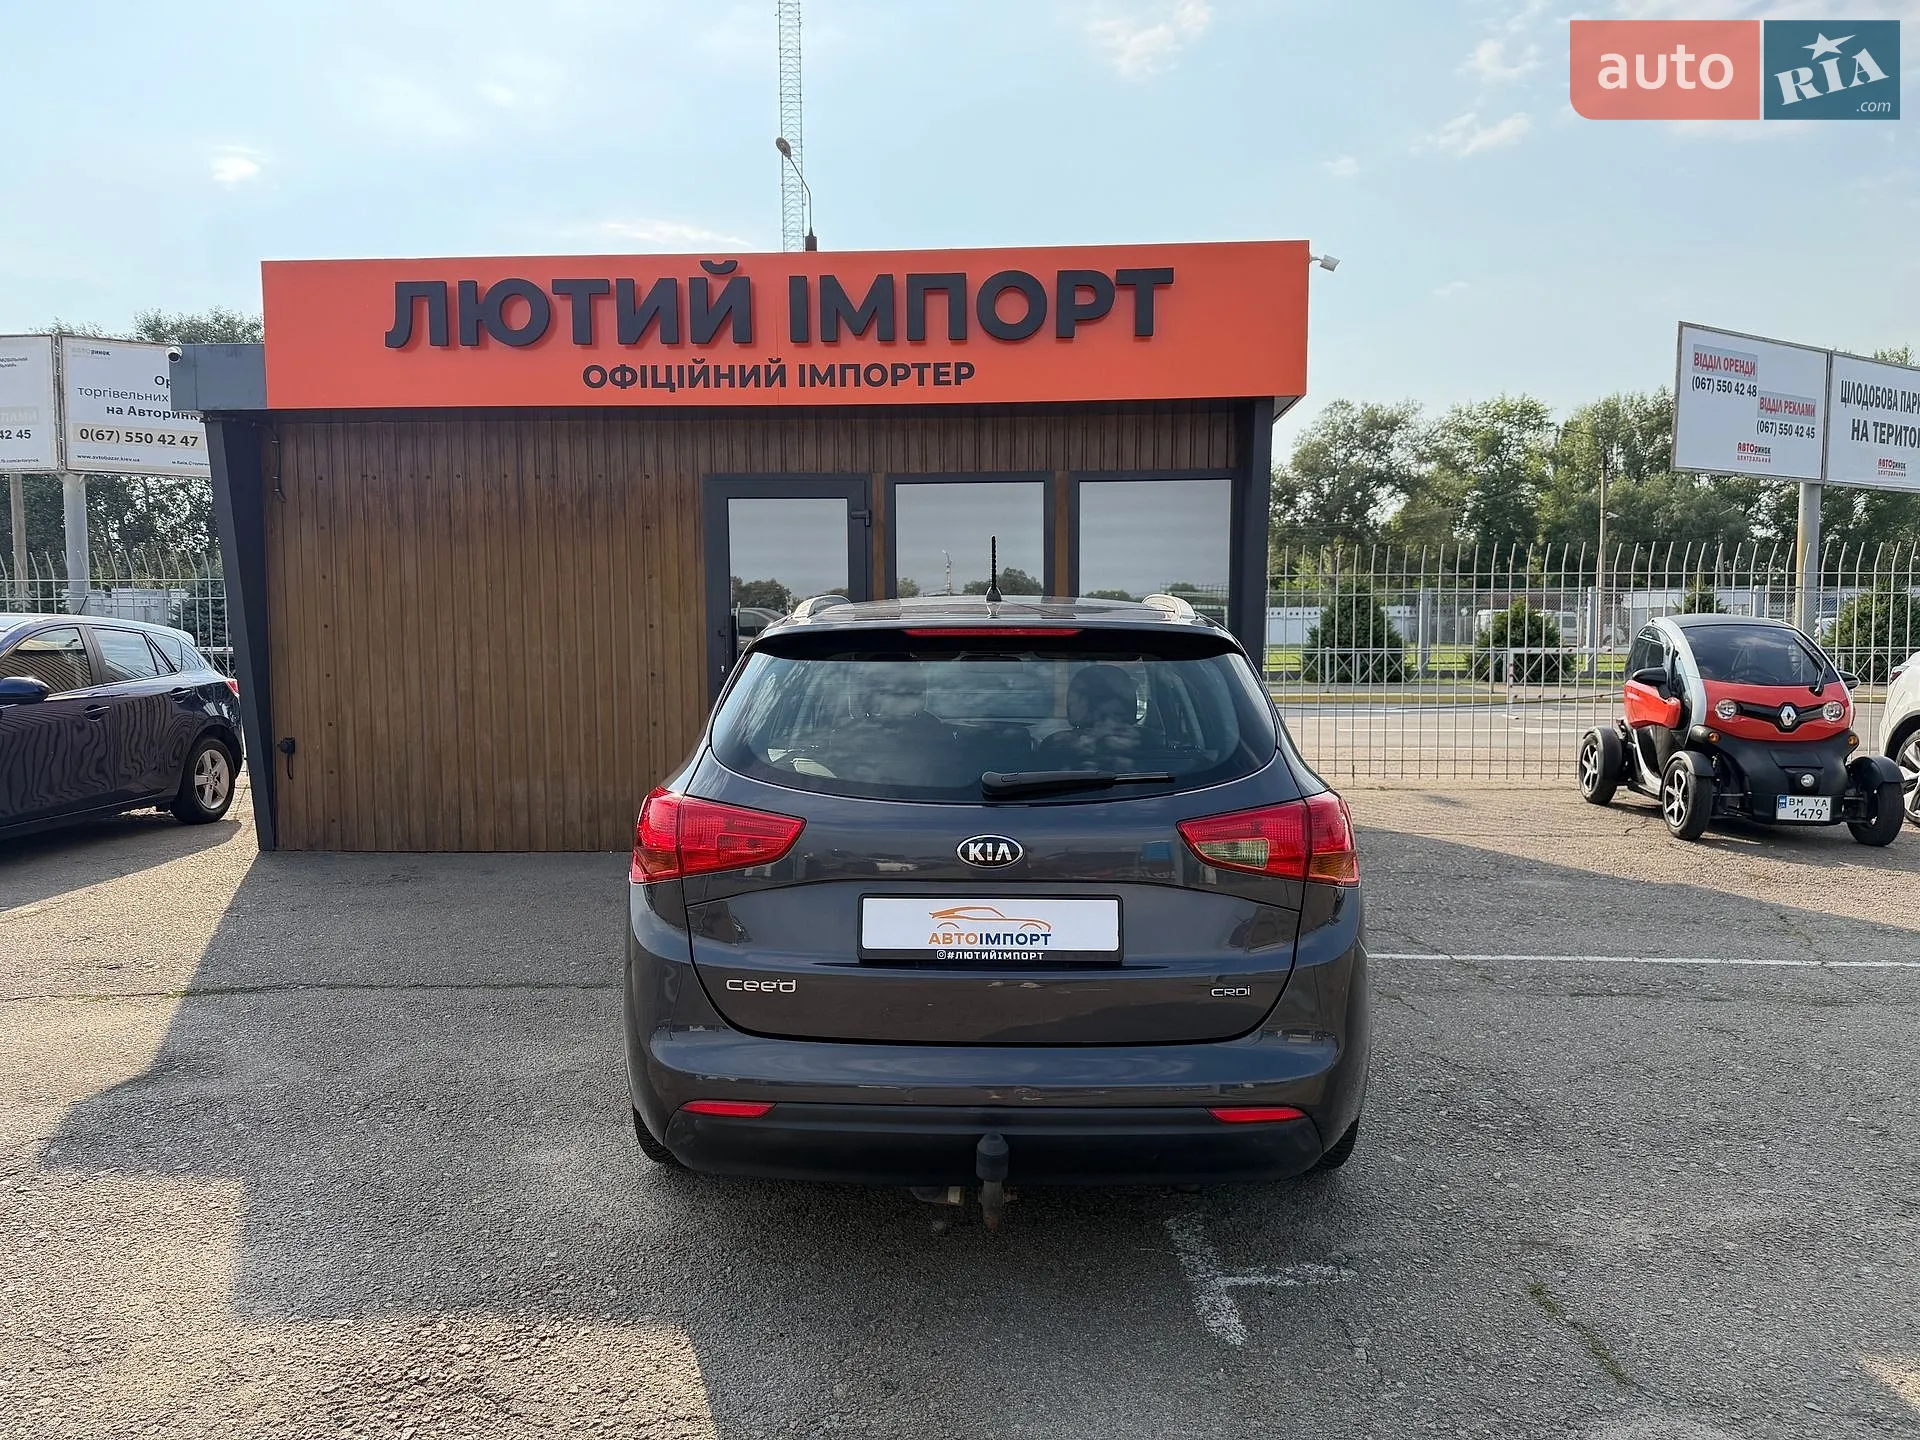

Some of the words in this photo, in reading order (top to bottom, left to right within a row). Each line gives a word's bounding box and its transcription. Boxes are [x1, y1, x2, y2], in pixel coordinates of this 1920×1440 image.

[385, 260, 753, 349] ЛЮТИЙ
[788, 267, 1174, 343] ІМПОРТ
[1693, 351, 1722, 372] ВІДДІЛ
[1723, 357, 1756, 377] ОРЕНДИ
[582, 358, 787, 393] ОФІЦІЙНИЙ
[799, 361, 976, 388] ІМПОРТЕР
[78, 386, 169, 402] торгівельних
[1691, 375, 1716, 394] (067)
[1716, 379, 1733, 394] 550
[1734, 382, 1745, 396] 42
[1747, 384, 1758, 398] 48
[1840, 380, 1898, 411] ЦІЛОДОБОВА
[106, 405, 123, 415] на
[127, 405, 201, 421] Авторинк
[1759, 396, 1783, 414] ВІДДІЛ
[1783, 400, 1816, 417] РЕКЛАМИ
[16, 429, 32, 440] 45
[80, 428, 120, 443] 0(67)
[125, 431, 153, 444] 550
[157, 433, 176, 446] 42
[179, 435, 199, 447] 47
[1756, 420, 1777, 437] (067)
[1778, 422, 1793, 436] 550
[1794, 425, 1804, 438] 42
[1805, 427, 1816, 439] 45
[1851, 418, 1869, 442] НА
[1788, 798, 1803, 806] BM
[1814, 799, 1827, 807] YA
[1793, 808, 1823, 819] 1479
[968, 842, 1012, 861] KIA
[928, 932, 1051, 946] АВТОІМПОРТ
[947, 950, 1045, 960] #ЛЮТИЙІМПОРТ
